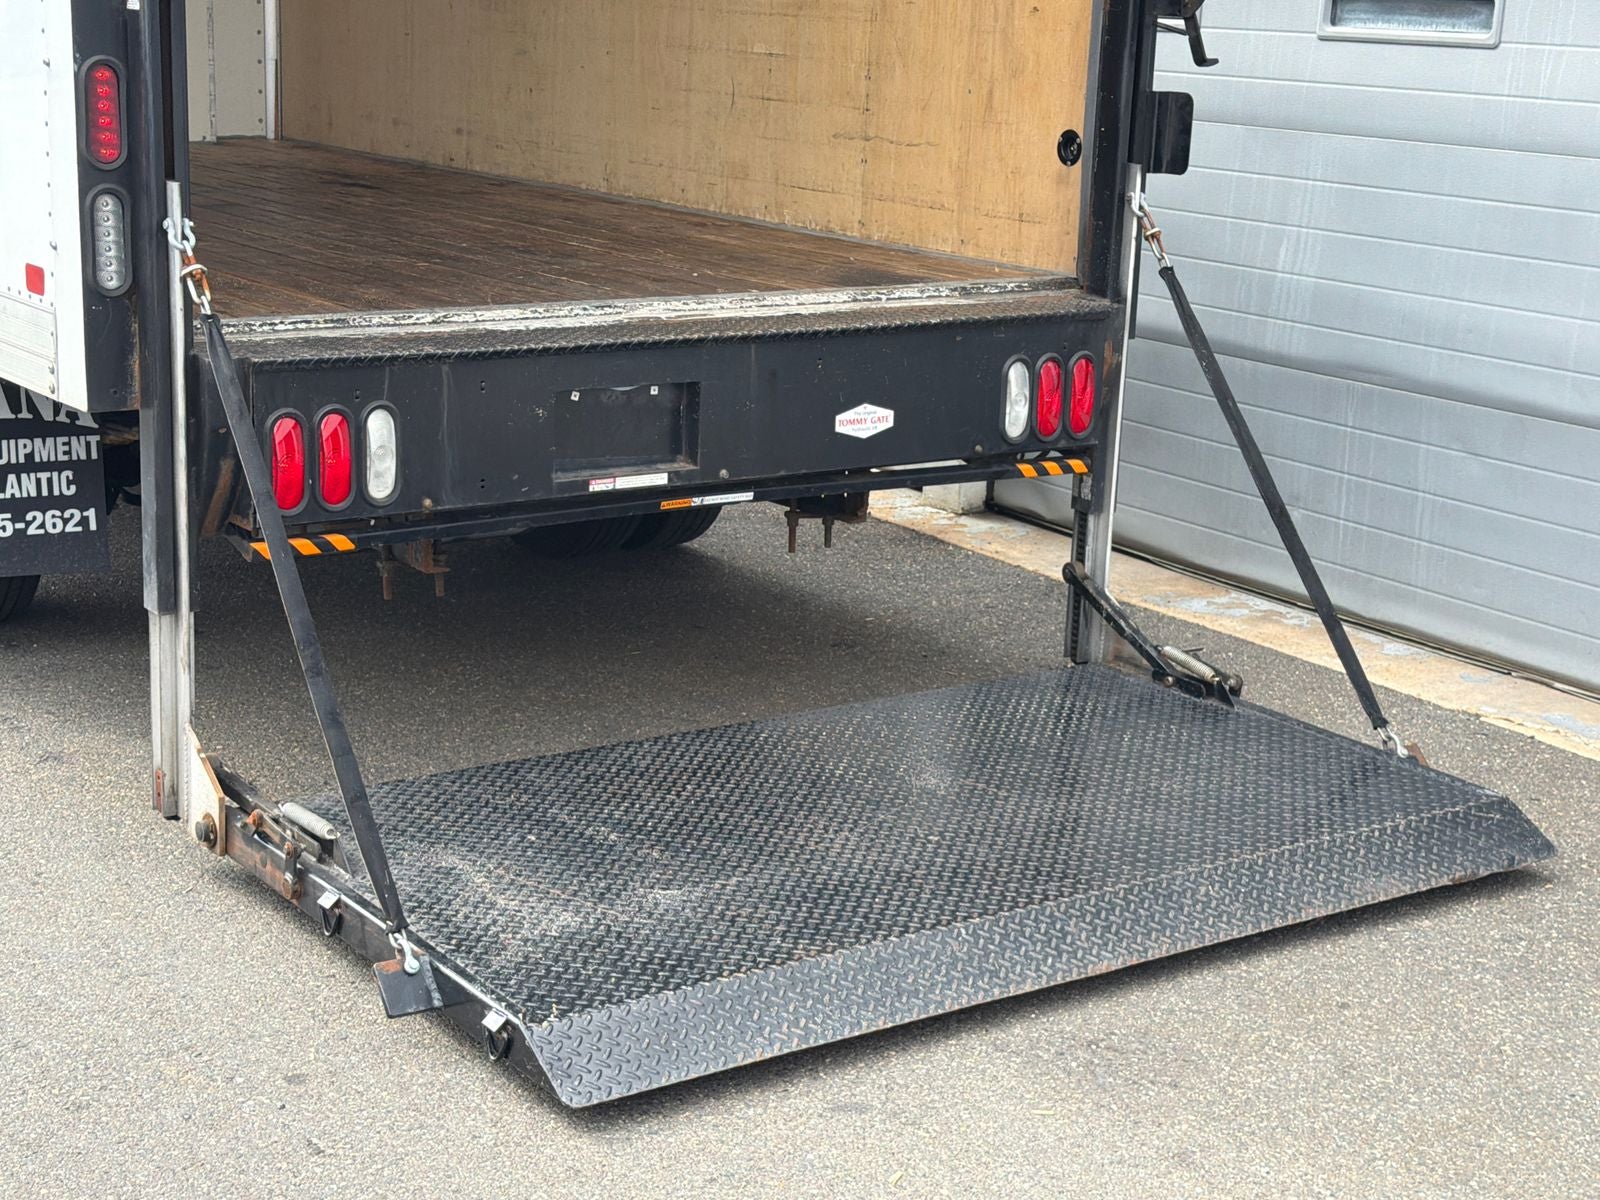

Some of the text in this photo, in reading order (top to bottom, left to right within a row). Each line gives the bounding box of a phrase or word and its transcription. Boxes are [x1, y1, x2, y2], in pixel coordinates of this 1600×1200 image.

[838, 415, 889, 427] TOMMY GATE
[0, 507, 97, 537] 5-2621
